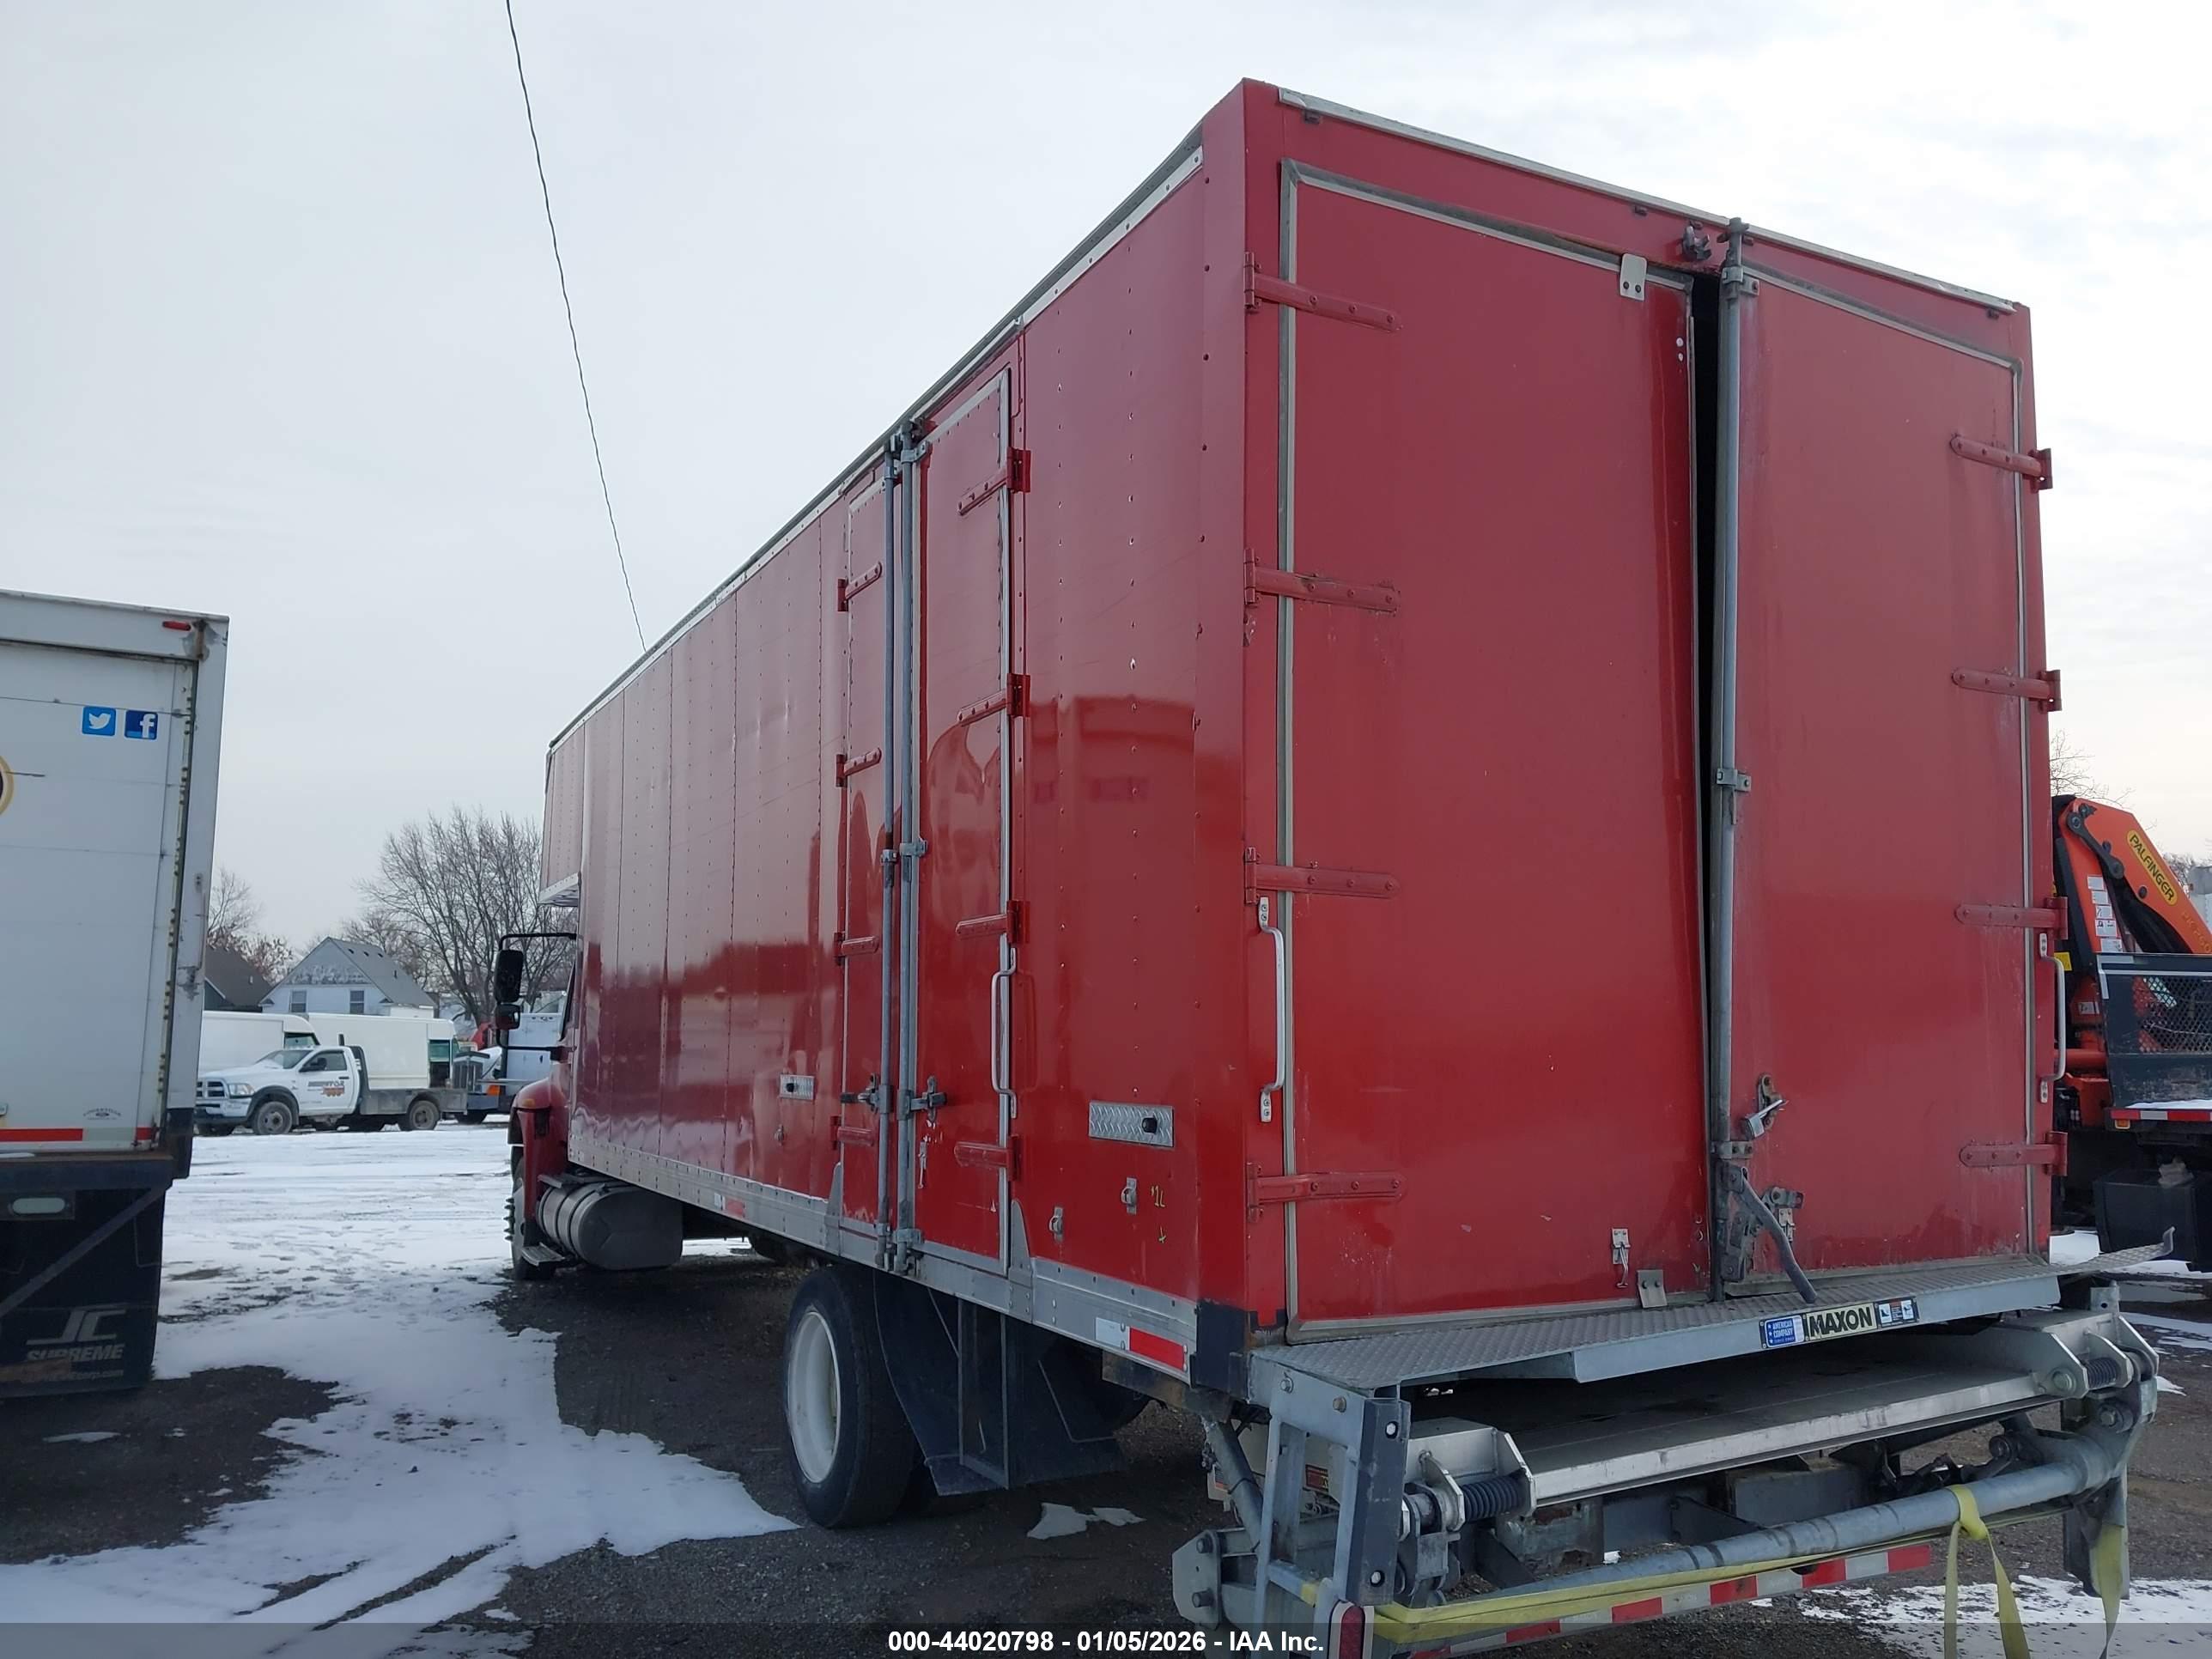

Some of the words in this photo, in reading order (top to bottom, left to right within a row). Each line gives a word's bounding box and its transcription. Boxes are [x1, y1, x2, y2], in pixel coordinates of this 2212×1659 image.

[2130, 834, 2175, 902] PALFINGER
[1771, 1318, 1794, 1331] AMERICAN
[1808, 1306, 1873, 1337] MAXON
[1772, 1327, 1795, 1339] COMPANY
[27, 1343, 125, 1363] SUPREME
